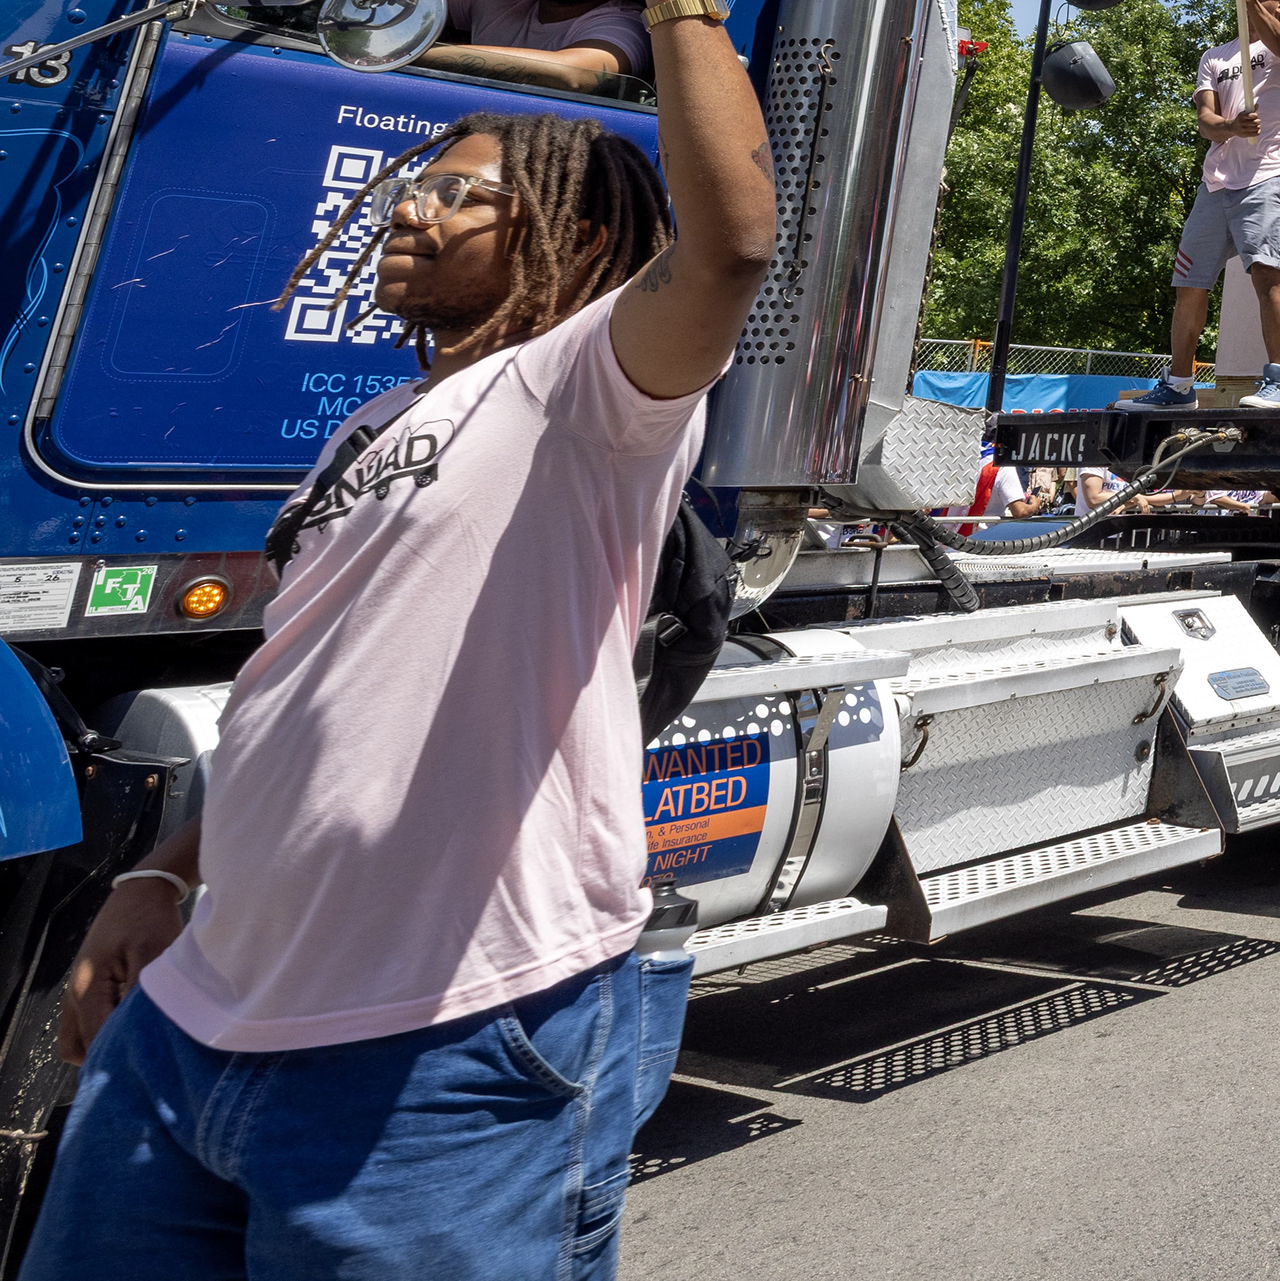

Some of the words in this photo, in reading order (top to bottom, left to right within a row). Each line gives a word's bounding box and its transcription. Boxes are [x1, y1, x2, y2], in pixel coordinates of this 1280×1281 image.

[5, 40, 72, 86] 13
[1232, 54, 1264, 74] DIAD
[337, 105, 449, 137] Floating
[301, 373, 346, 393] ICC
[281, 419, 318, 439] US
[642, 739, 763, 785] WANTED
[640, 776, 748, 823] ATBED
[658, 826, 667, 837] &
[669, 818, 711, 835] Personal
[646, 841, 659, 851] ife
[661, 831, 708, 848] Insurance
[653, 845, 713, 872] NIGHT
